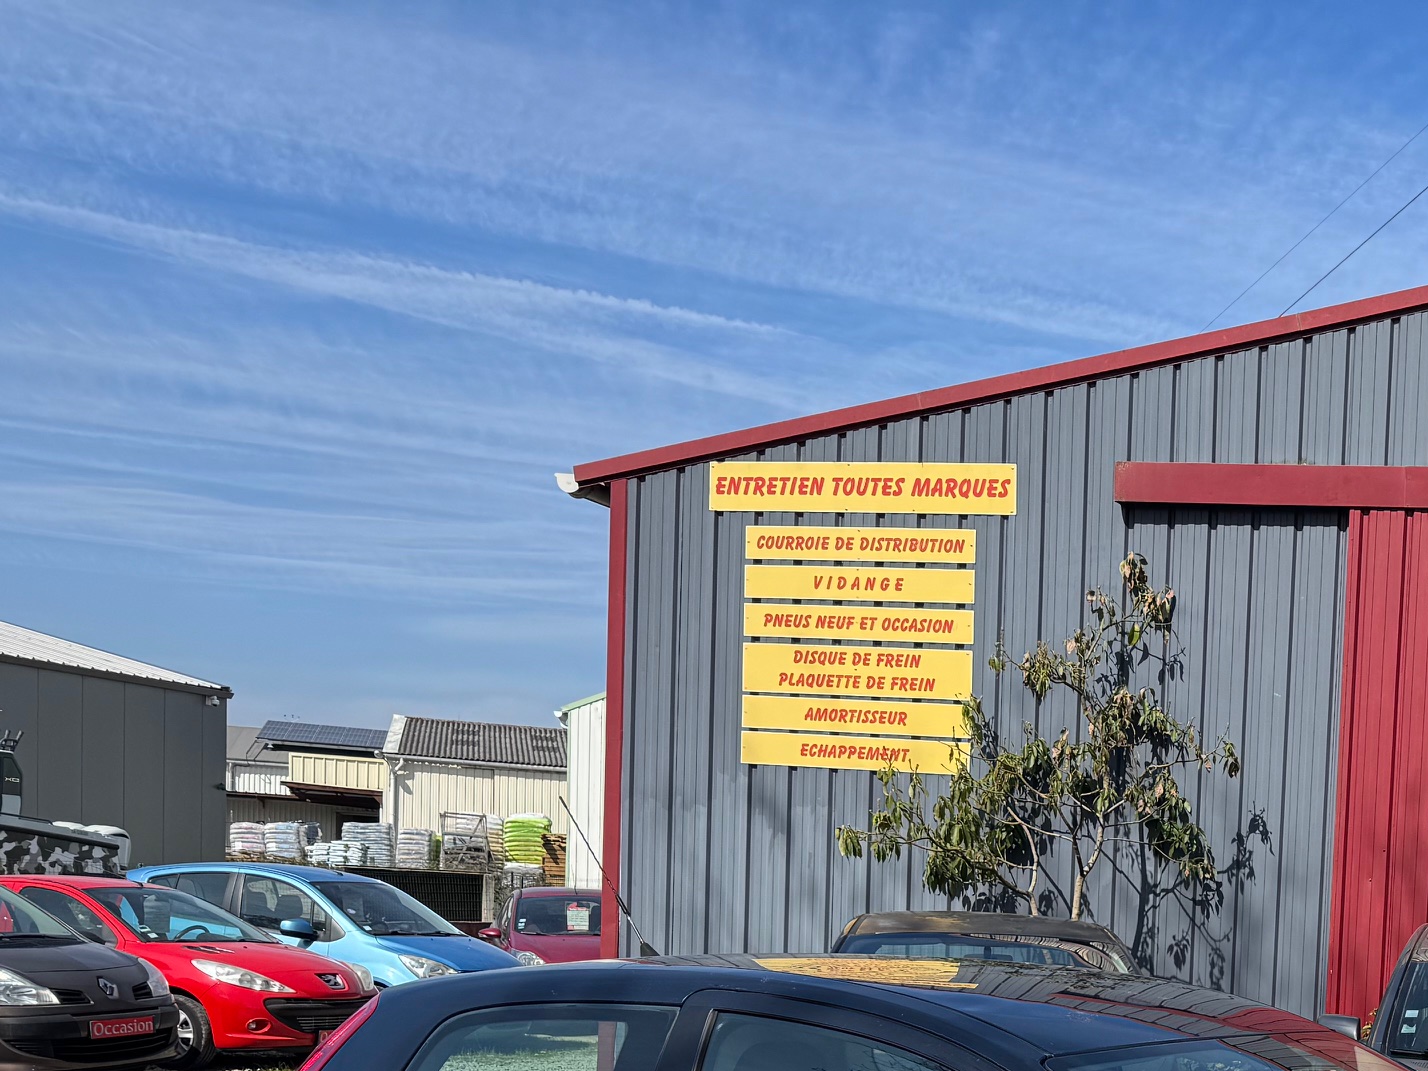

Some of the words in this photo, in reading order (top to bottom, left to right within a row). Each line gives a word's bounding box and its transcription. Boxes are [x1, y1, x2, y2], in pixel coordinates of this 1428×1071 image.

[715, 476, 825, 497] ENTRETIEN
[831, 477, 906, 498] TOUTES
[911, 478, 1011, 499] MARQUES
[757, 535, 830, 551] COURROIE
[835, 536, 855, 551] DE
[859, 536, 965, 554] DISTRIBUTION
[813, 575, 904, 592] VIDANGE
[764, 613, 812, 629] PNEUS
[815, 615, 855, 630] NEUF
[859, 616, 878, 631] ET
[881, 617, 954, 634] OCCASION
[793, 650, 847, 667] DISQUE
[851, 652, 872, 667] DE
[876, 653, 922, 669] FREIN
[778, 672, 861, 690] PLAQUETTE
[865, 675, 886, 690] DE
[890, 676, 936, 692] FREIN
[804, 707, 908, 726] AMORTISSEUR
[800, 743, 910, 763] ECHAPPEMENT
[93, 1020, 154, 1037] Occasion
